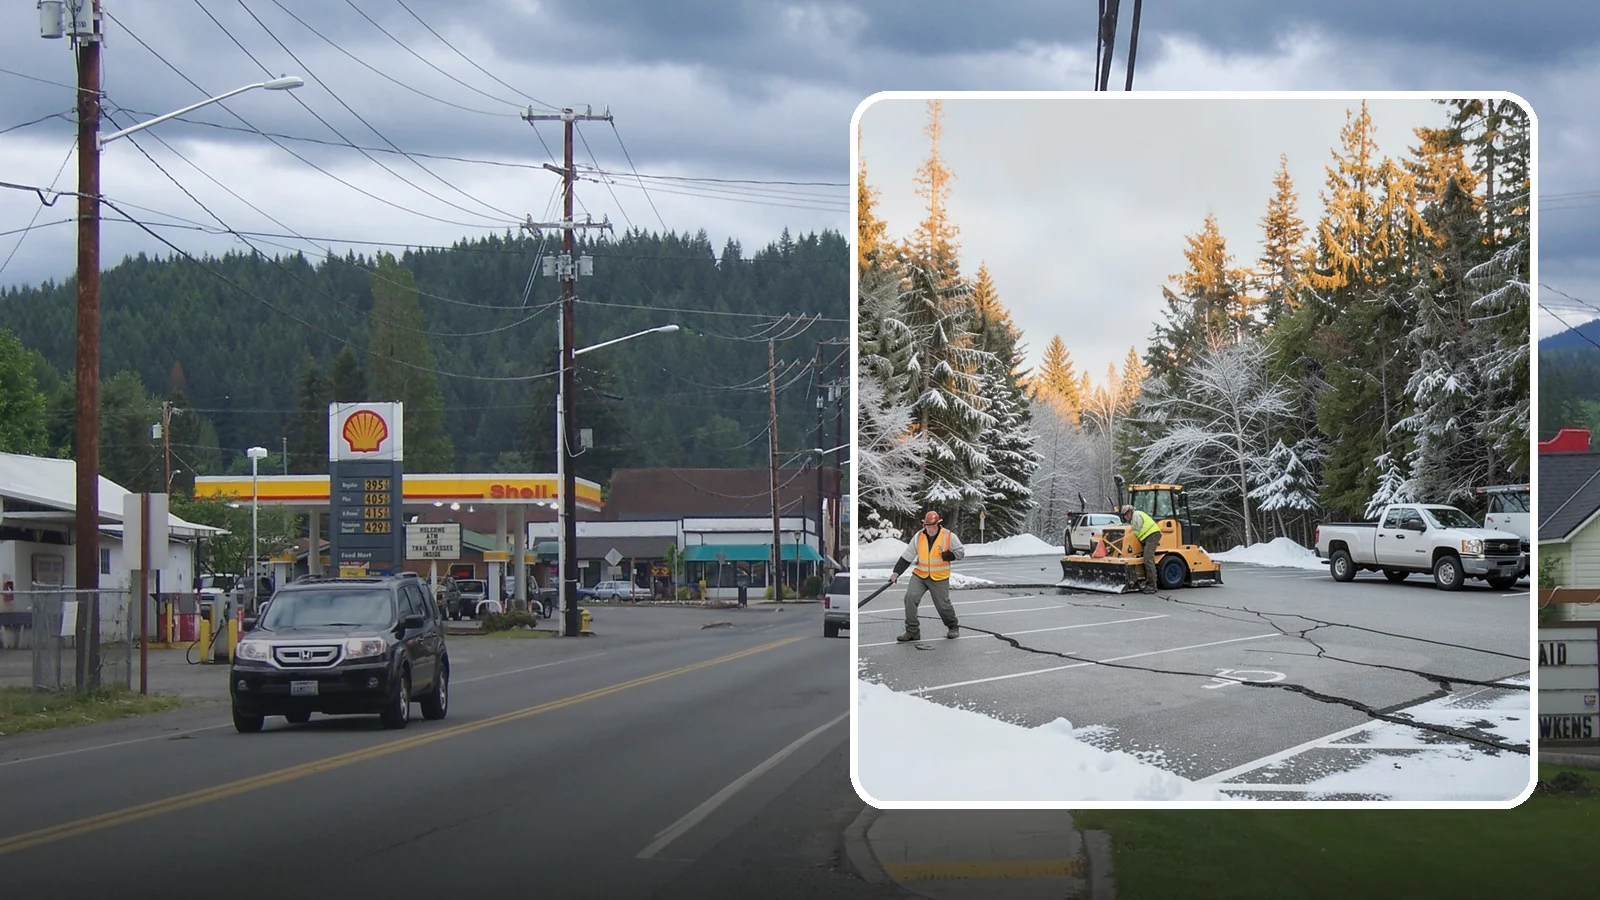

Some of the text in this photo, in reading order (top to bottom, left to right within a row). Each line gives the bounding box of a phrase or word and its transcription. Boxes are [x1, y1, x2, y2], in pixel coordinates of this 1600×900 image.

[366, 480, 384, 490] 395
[490, 484, 547, 499] Shell
[366, 494, 384, 504] 405
[366, 508, 384, 518] 415
[366, 522, 384, 533] 429
[1539, 643, 1567, 665] AID
